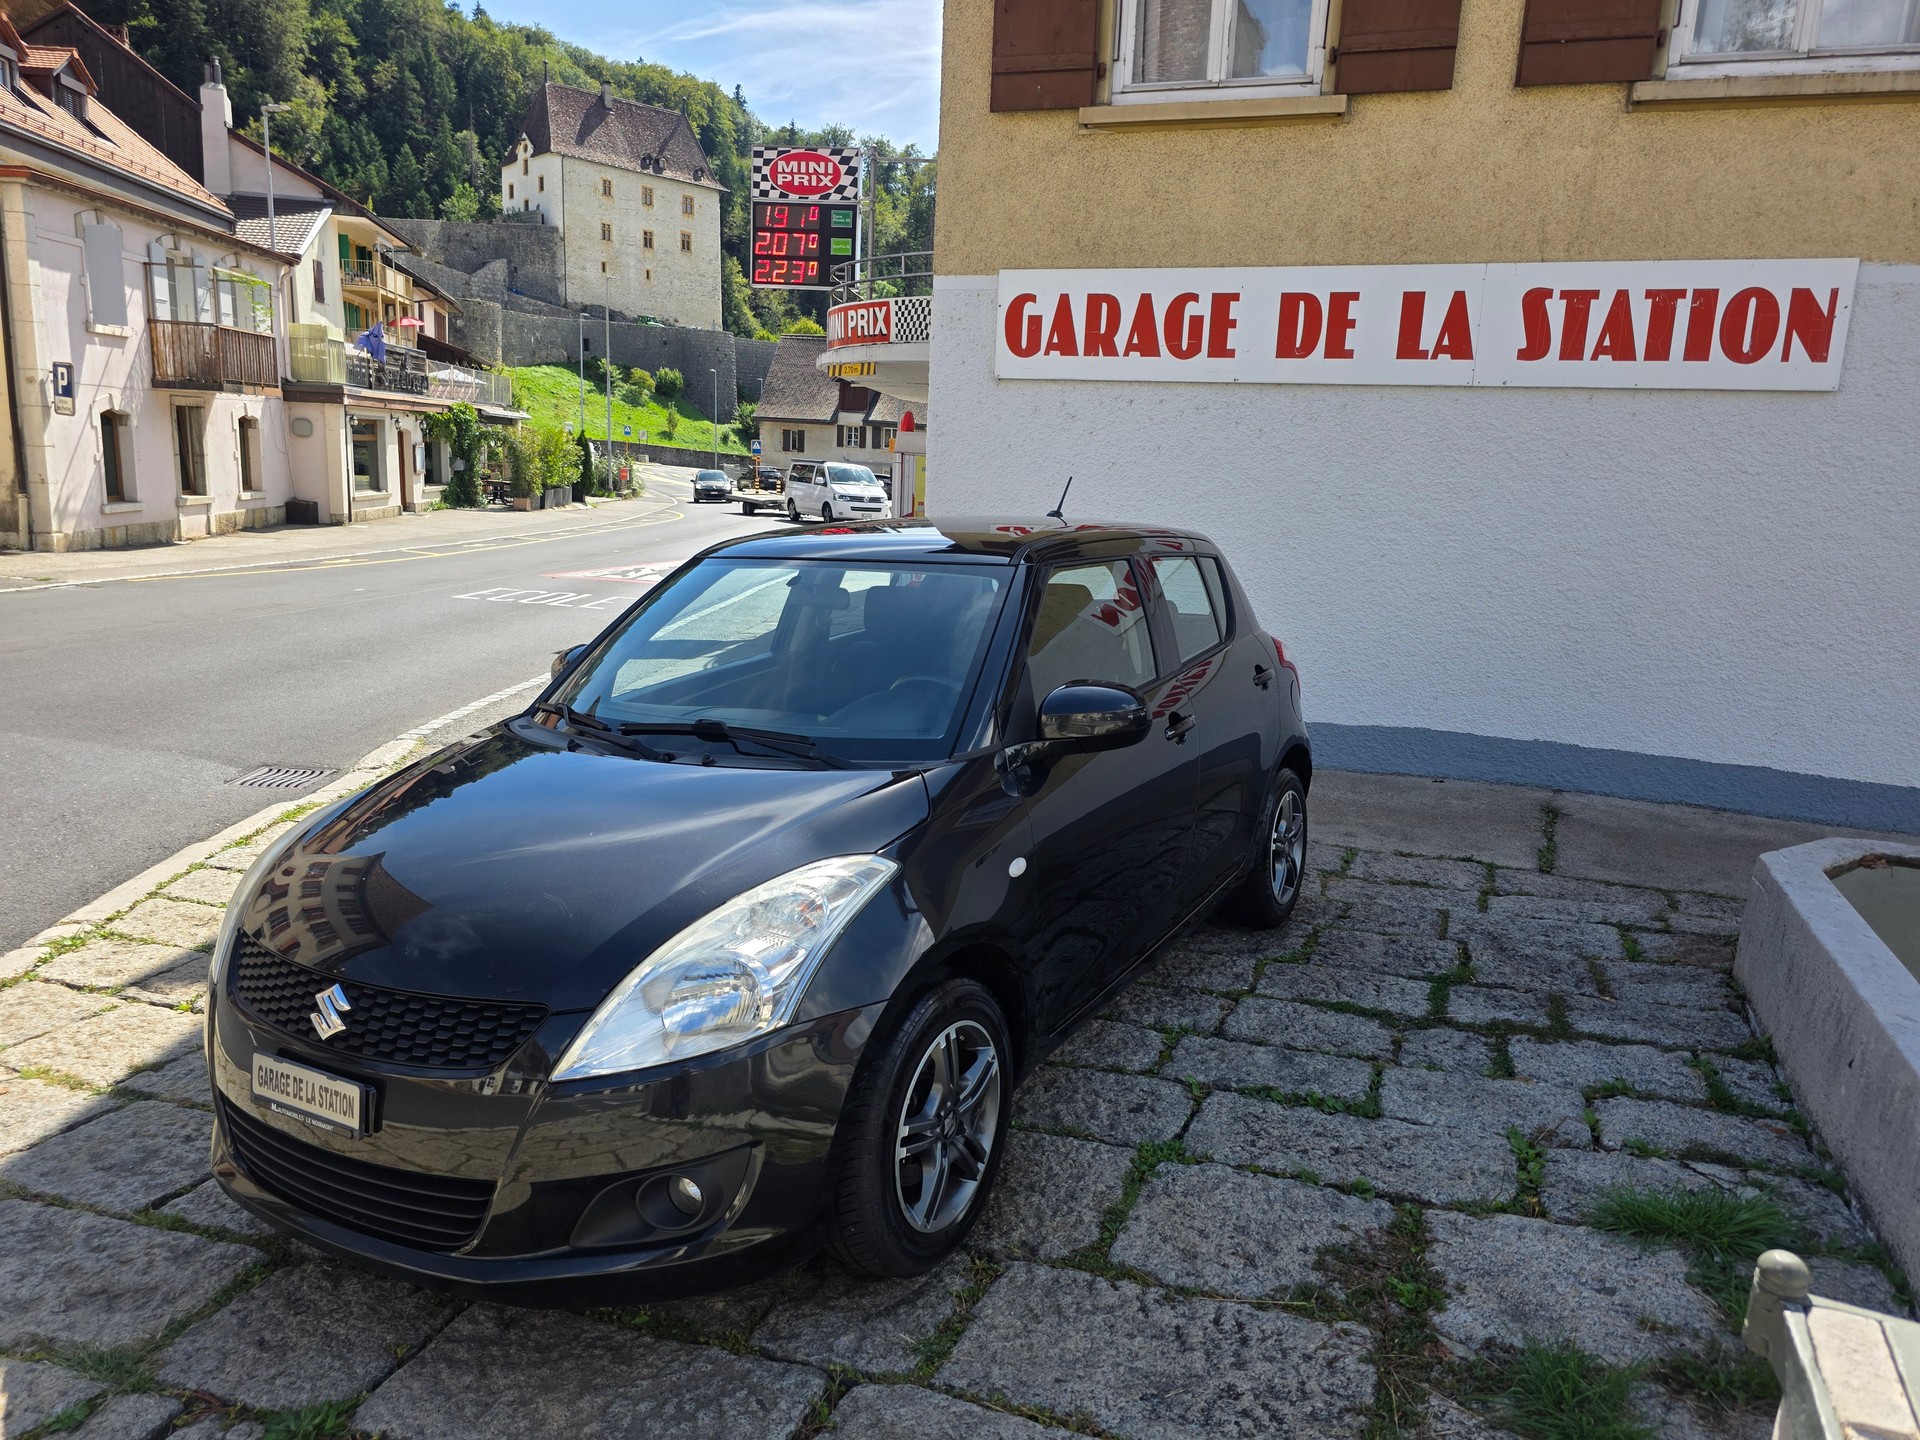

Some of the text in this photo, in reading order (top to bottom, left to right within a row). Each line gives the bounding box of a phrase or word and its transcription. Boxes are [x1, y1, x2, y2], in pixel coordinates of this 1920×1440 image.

[777, 160, 834, 174] MINI
[777, 173, 834, 187] PRIX
[847, 306, 888, 338] PRIX
[1004, 287, 1838, 364] GARAGE DE LA STATION
[57, 366, 68, 394] P
[451, 587, 641, 610] ECOLE
[257, 1064, 355, 1119] GARAGE DE LA STATION
